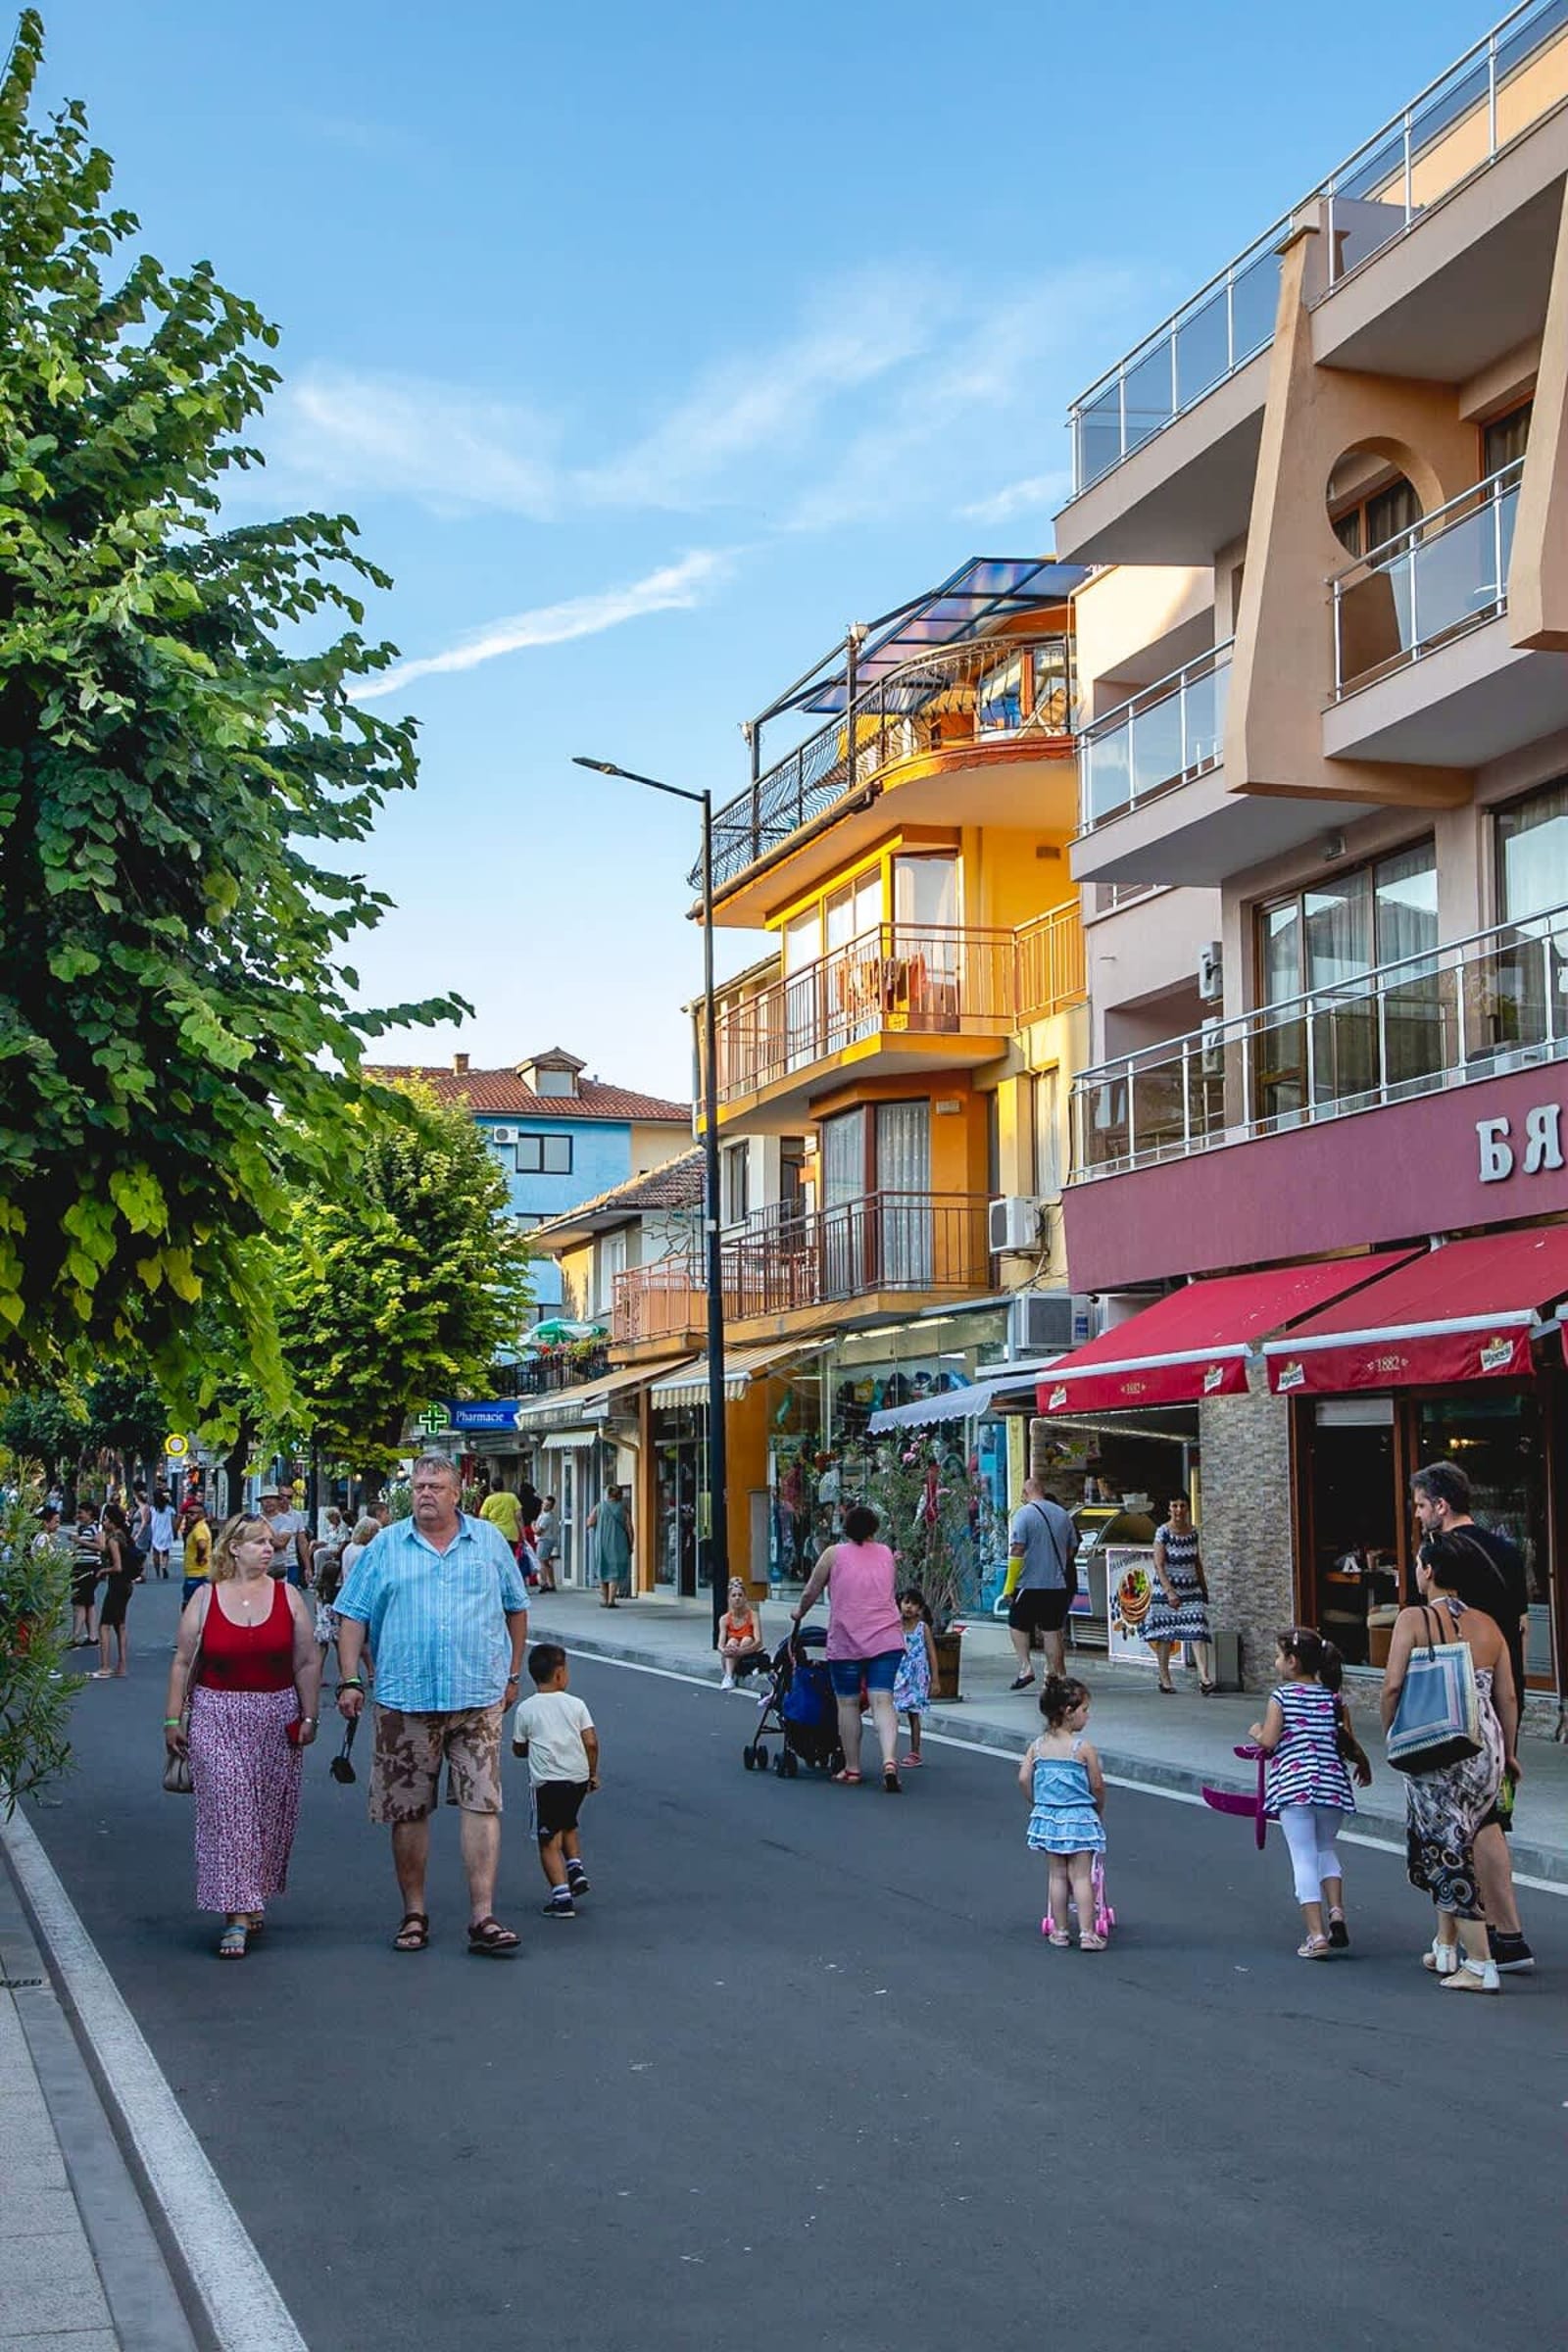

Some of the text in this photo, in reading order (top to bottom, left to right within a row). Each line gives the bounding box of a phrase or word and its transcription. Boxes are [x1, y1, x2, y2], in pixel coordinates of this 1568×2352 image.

[1476, 1103, 1564, 1182] БЯ
[1377, 1355, 1399, 1372] 1882
[456, 1410, 505, 1422] Pharmacie
